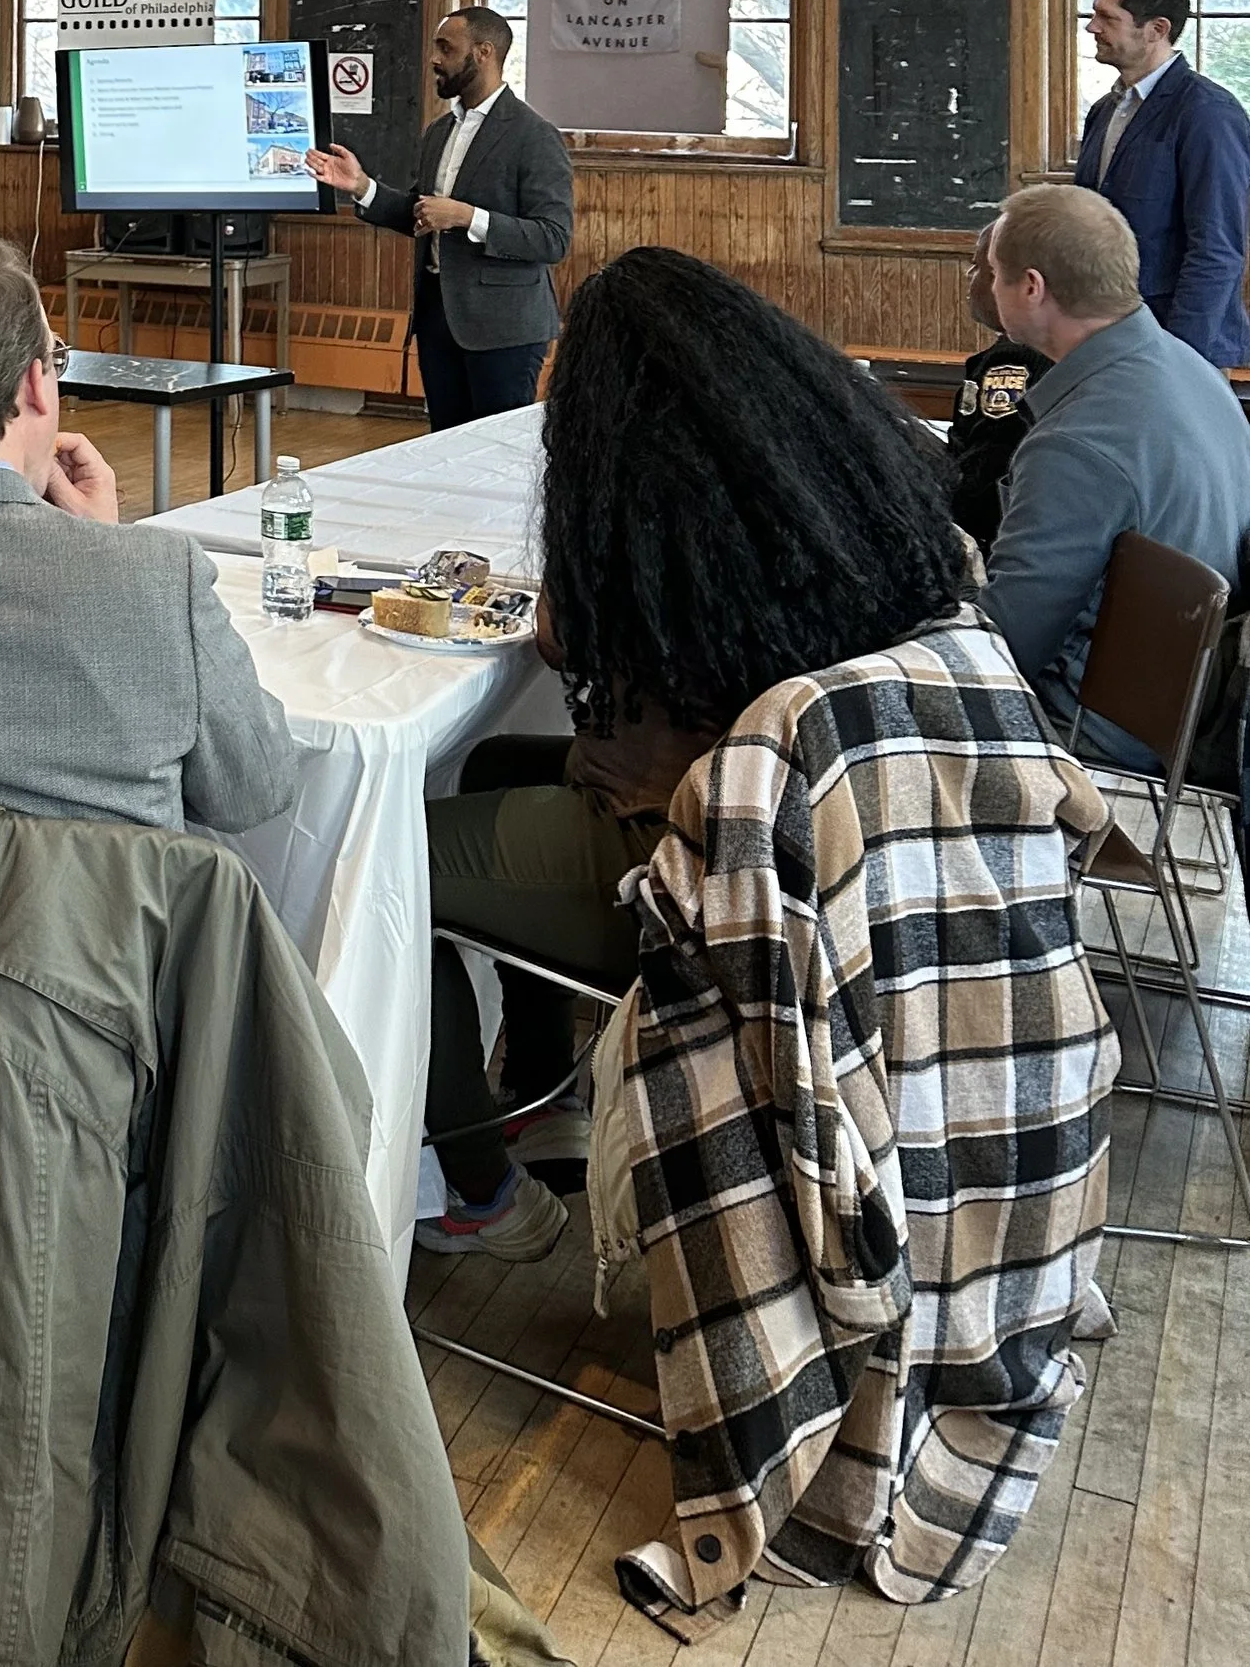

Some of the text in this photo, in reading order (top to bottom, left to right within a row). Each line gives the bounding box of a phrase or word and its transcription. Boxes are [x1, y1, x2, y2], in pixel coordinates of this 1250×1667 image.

[125, 1, 214, 15] of Philadelphia
[566, 13, 666, 27] LANCASTER
[581, 36, 649, 49] AVENUE
[984, 376, 1024, 390] POLICE
